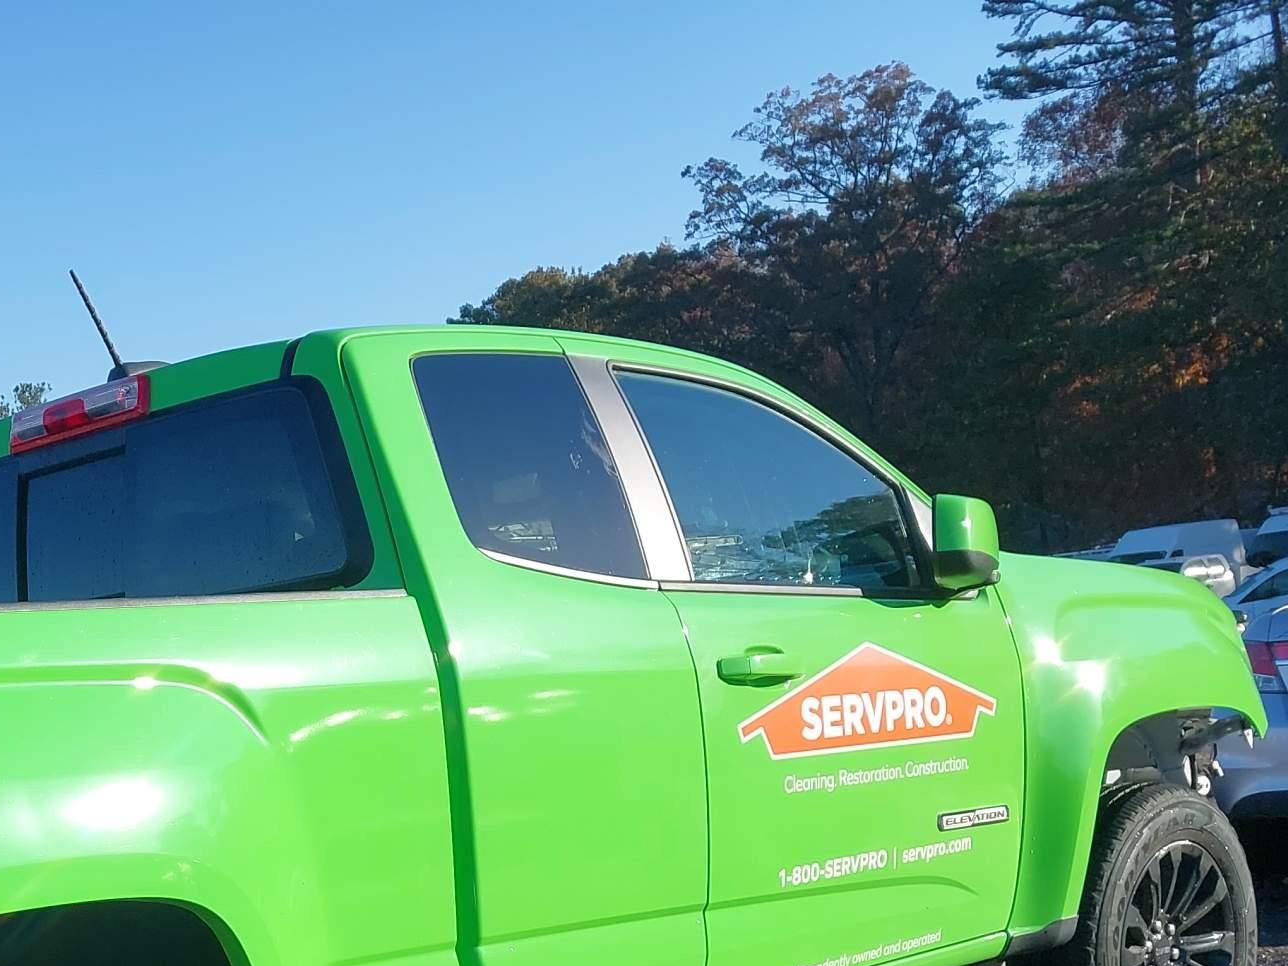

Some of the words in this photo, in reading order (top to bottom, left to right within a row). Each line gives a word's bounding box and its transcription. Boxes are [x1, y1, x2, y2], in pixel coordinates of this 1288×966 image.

[784, 772, 837, 793] Cleaning.
[839, 764, 904, 787] Restoration.
[905, 756, 969, 778] Construction.
[945, 809, 1005, 827] ELEVATION
[778, 849, 888, 888] 1-800-SERVPRO
[902, 837, 972, 864] servpro.com
[852, 945, 882, 964] owned
[883, 939, 901, 956] and
[902, 928, 942, 954] operated
